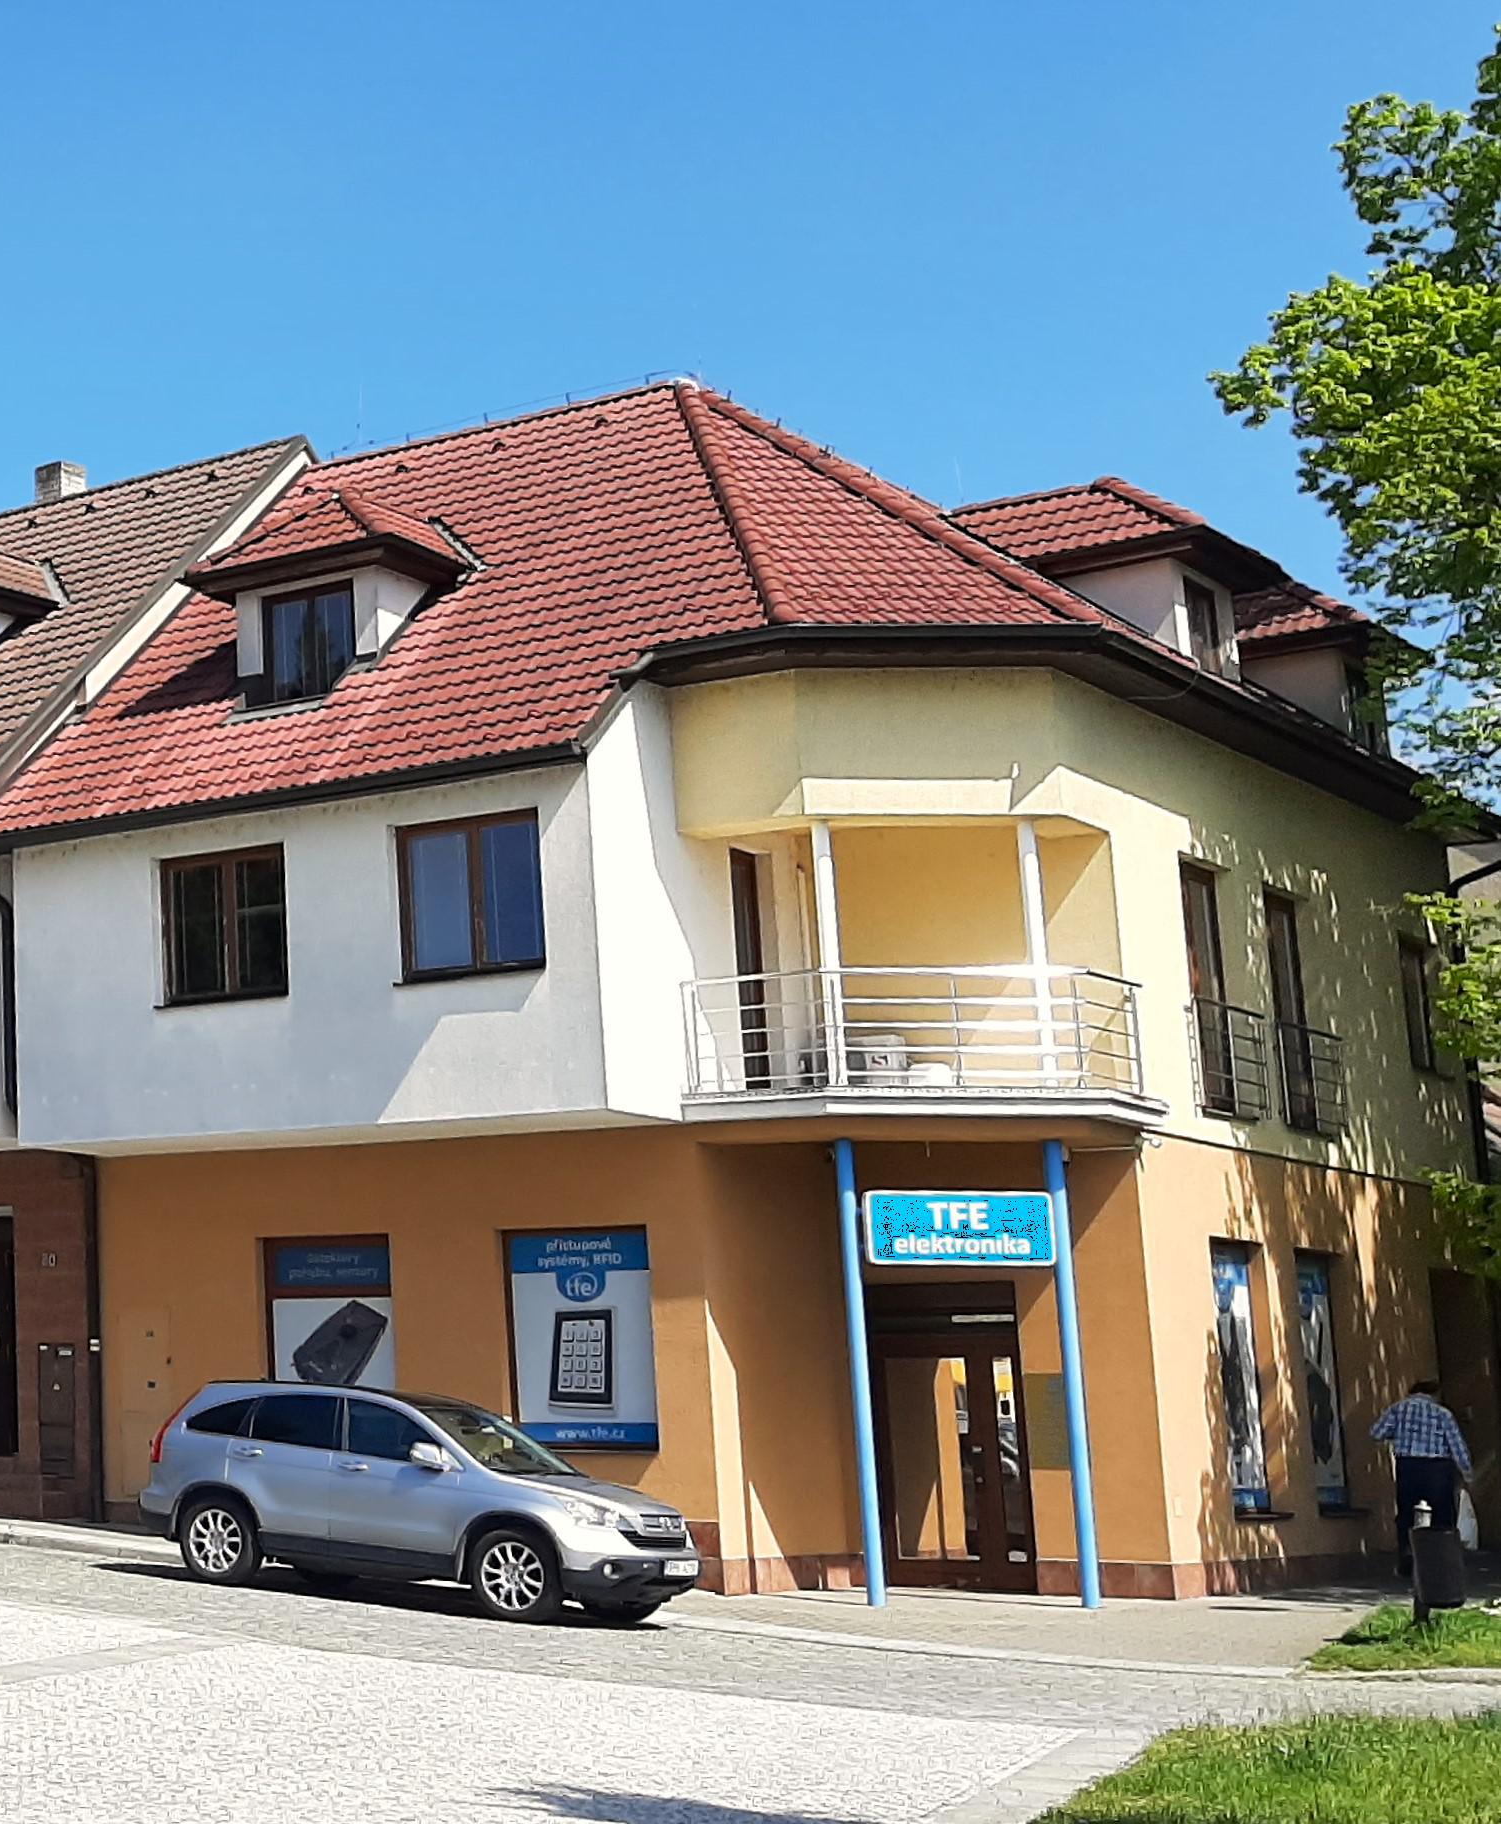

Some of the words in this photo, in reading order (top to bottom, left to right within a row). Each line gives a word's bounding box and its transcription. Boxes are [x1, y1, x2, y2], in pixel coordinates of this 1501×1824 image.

[926, 1201, 990, 1231] TFE
[893, 1232, 1032, 1255] elektronika
[537, 1254, 590, 1268] systémy,
[593, 1252, 622, 1266] RFID
[565, 1273, 598, 1297] tfe
